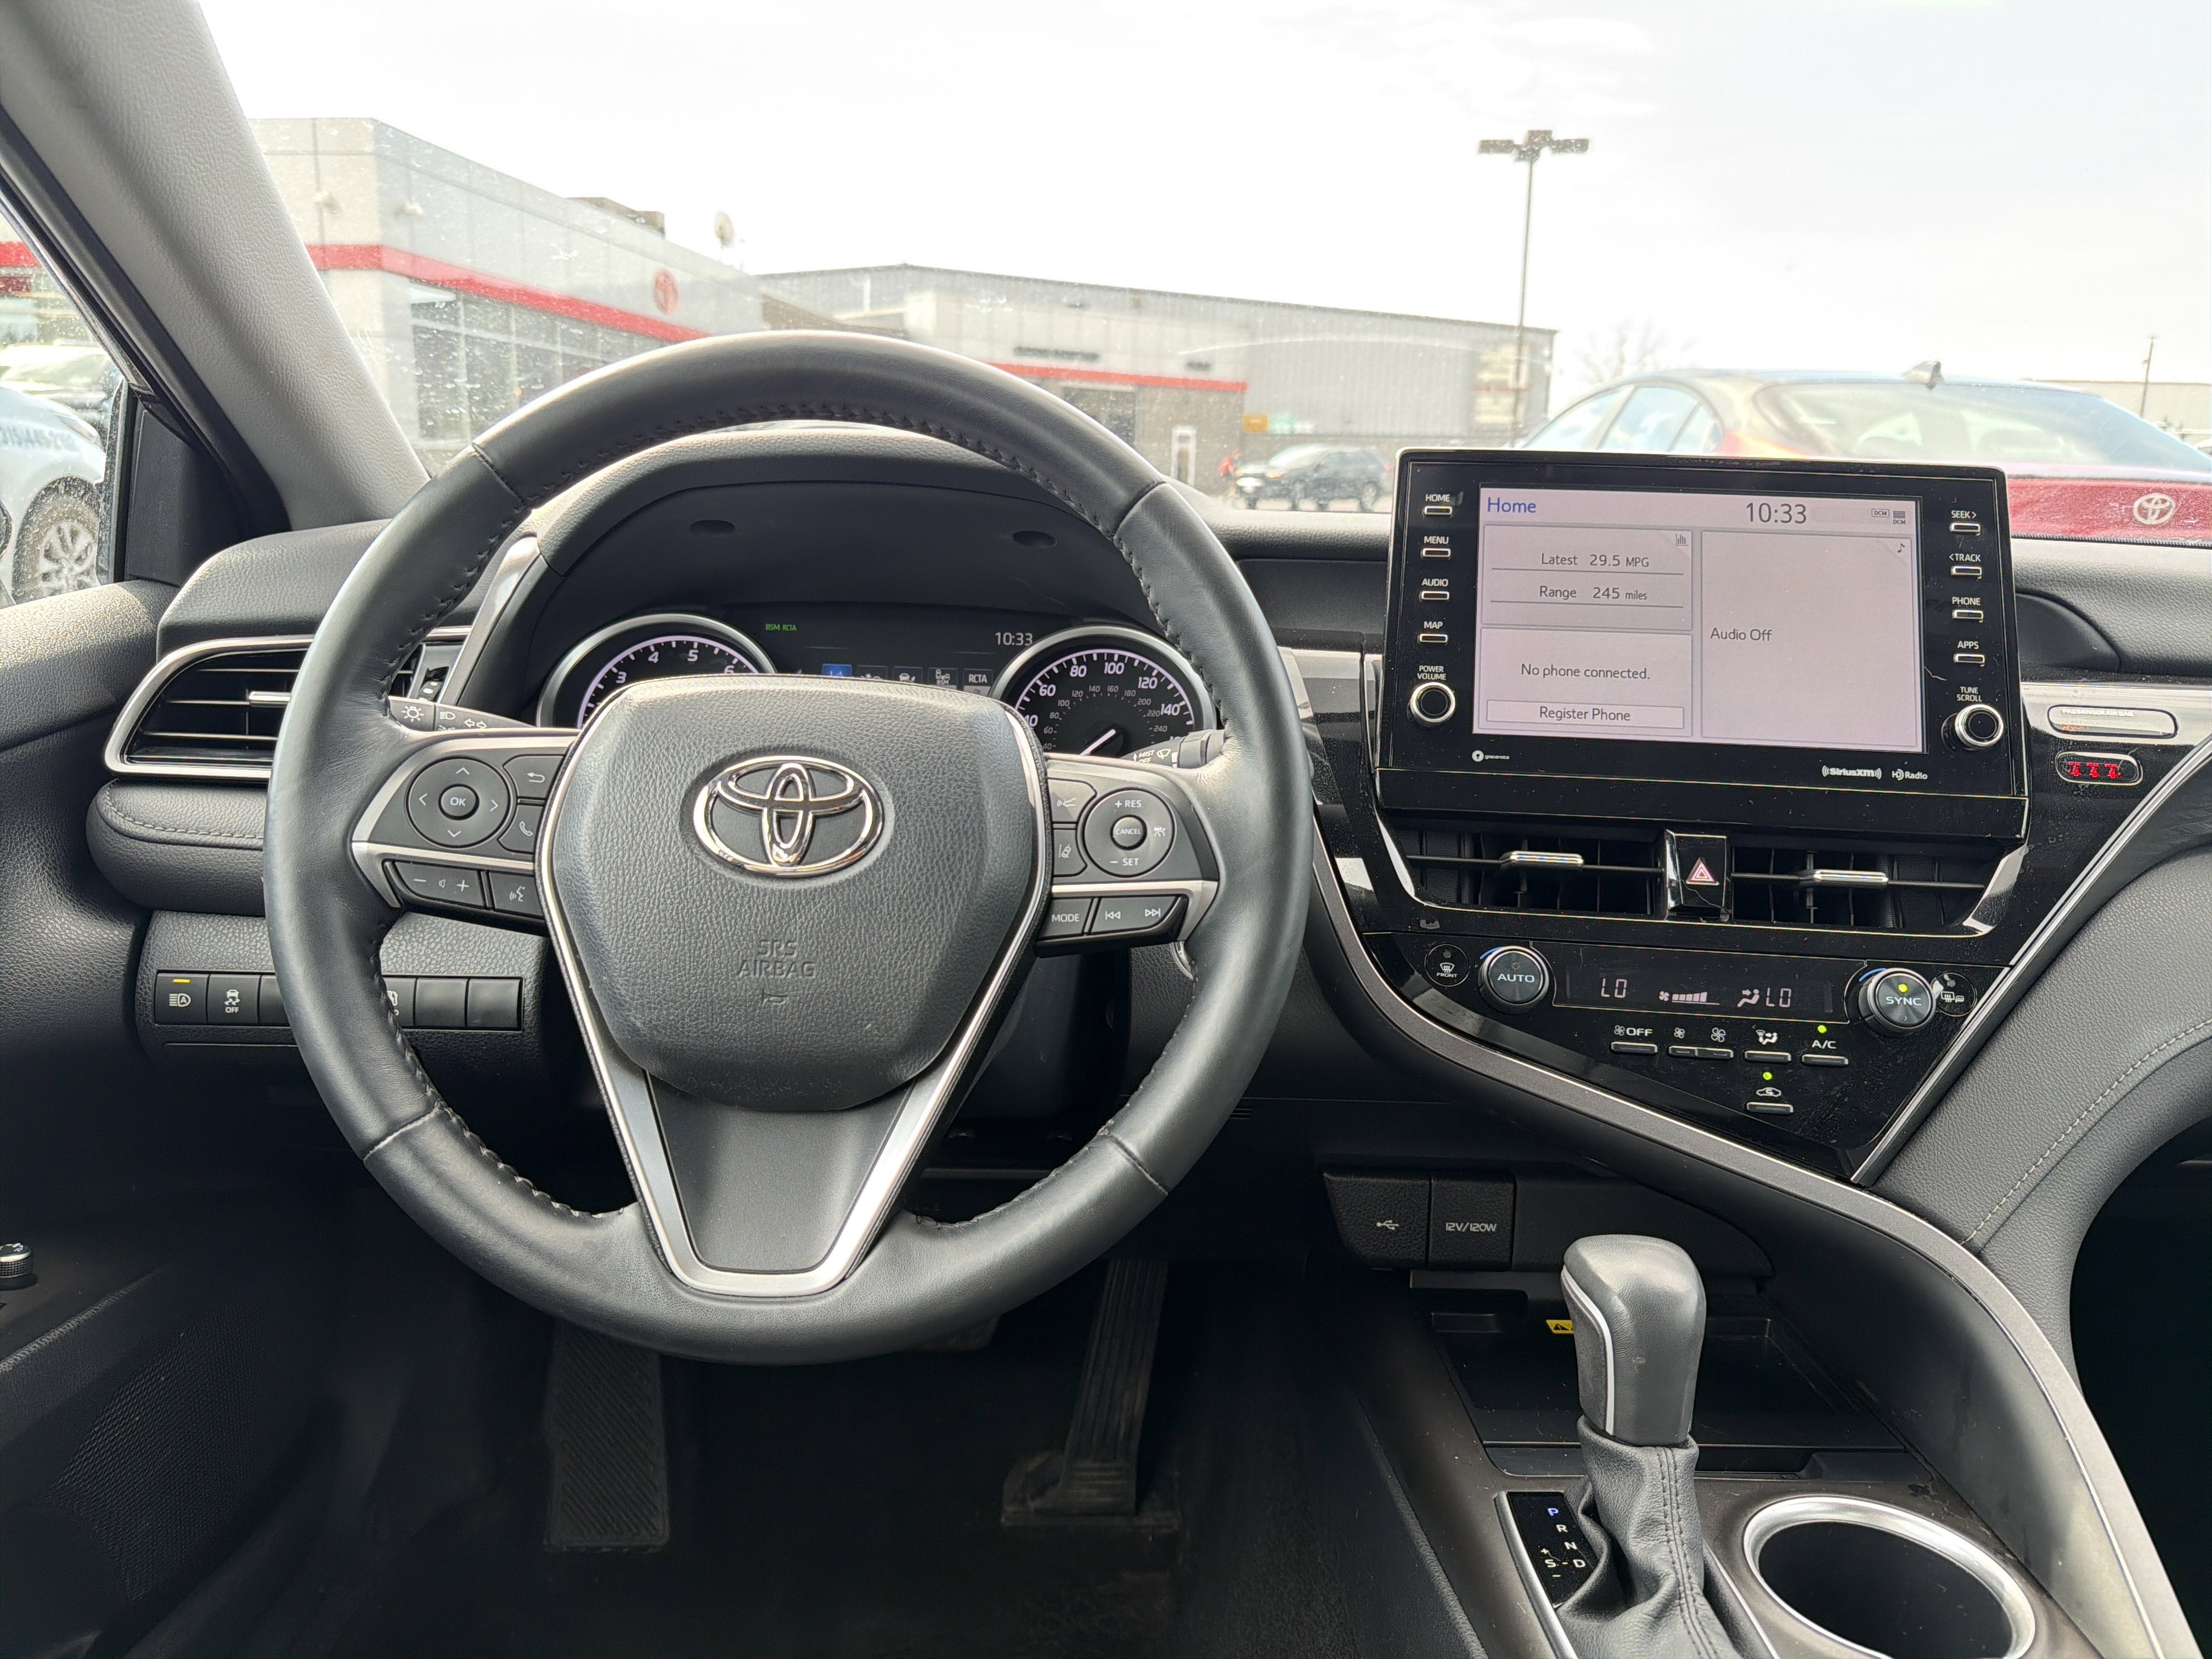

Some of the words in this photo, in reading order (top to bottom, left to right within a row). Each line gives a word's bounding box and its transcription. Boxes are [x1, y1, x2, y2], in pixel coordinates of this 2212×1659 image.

[1425, 494, 1450, 503] HOME
[1487, 496, 1537, 514] Home
[1746, 503, 1807, 524] 10:33
[1424, 535, 1449, 545] MENU
[1541, 554, 1578, 567] Latest
[1589, 554, 1621, 567] 29.5
[1626, 557, 1650, 568] MPG
[1421, 578, 1448, 587] AUDIO
[1539, 586, 1577, 600] Range
[1593, 587, 1620, 600] 245
[1625, 589, 1647, 601] miles
[1952, 597, 1981, 606] PHONE
[1424, 621, 1443, 629] MAP
[995, 631, 1034, 646] 10:33
[1710, 628, 1746, 640] Audio
[1750, 629, 1772, 641] Off
[1957, 641, 1979, 650] APPS
[648, 651, 659, 663] 4
[687, 649, 699, 662] 5
[1069, 665, 1087, 678] 80
[1104, 662, 1125, 675] 100
[1521, 664, 1539, 676] No
[1543, 665, 1581, 681] phone
[1584, 666, 1651, 680] connected.
[616, 671, 627, 684] 3
[968, 674, 988, 683] RCTA
[1137, 676, 1158, 689] 120
[1039, 684, 1056, 697] 60
[1071, 690, 1084, 698] 120
[1956, 694, 1982, 702] SCROLL
[1160, 703, 1181, 716] 140
[1539, 707, 1589, 722] Register
[1592, 708, 1631, 721] Phone
[1905, 771, 1928, 780] Radio
[450, 796, 466, 808] OK
[1124, 799, 1142, 808] RES
[1122, 857, 1139, 866] SET
[1051, 913, 1080, 923] MODE
[736, 960, 816, 978] AIRBAG
[1497, 973, 1535, 983] AUTO
[1886, 996, 1922, 1006] SYNC
[1626, 1028, 1652, 1036] OFF
[1812, 1040, 1837, 1049] A/C
[1445, 1222, 1497, 1233] 12V/120W
[1547, 1508, 1559, 1516] P
[1556, 1524, 1568, 1532] R
[1564, 1542, 1577, 1550] N
